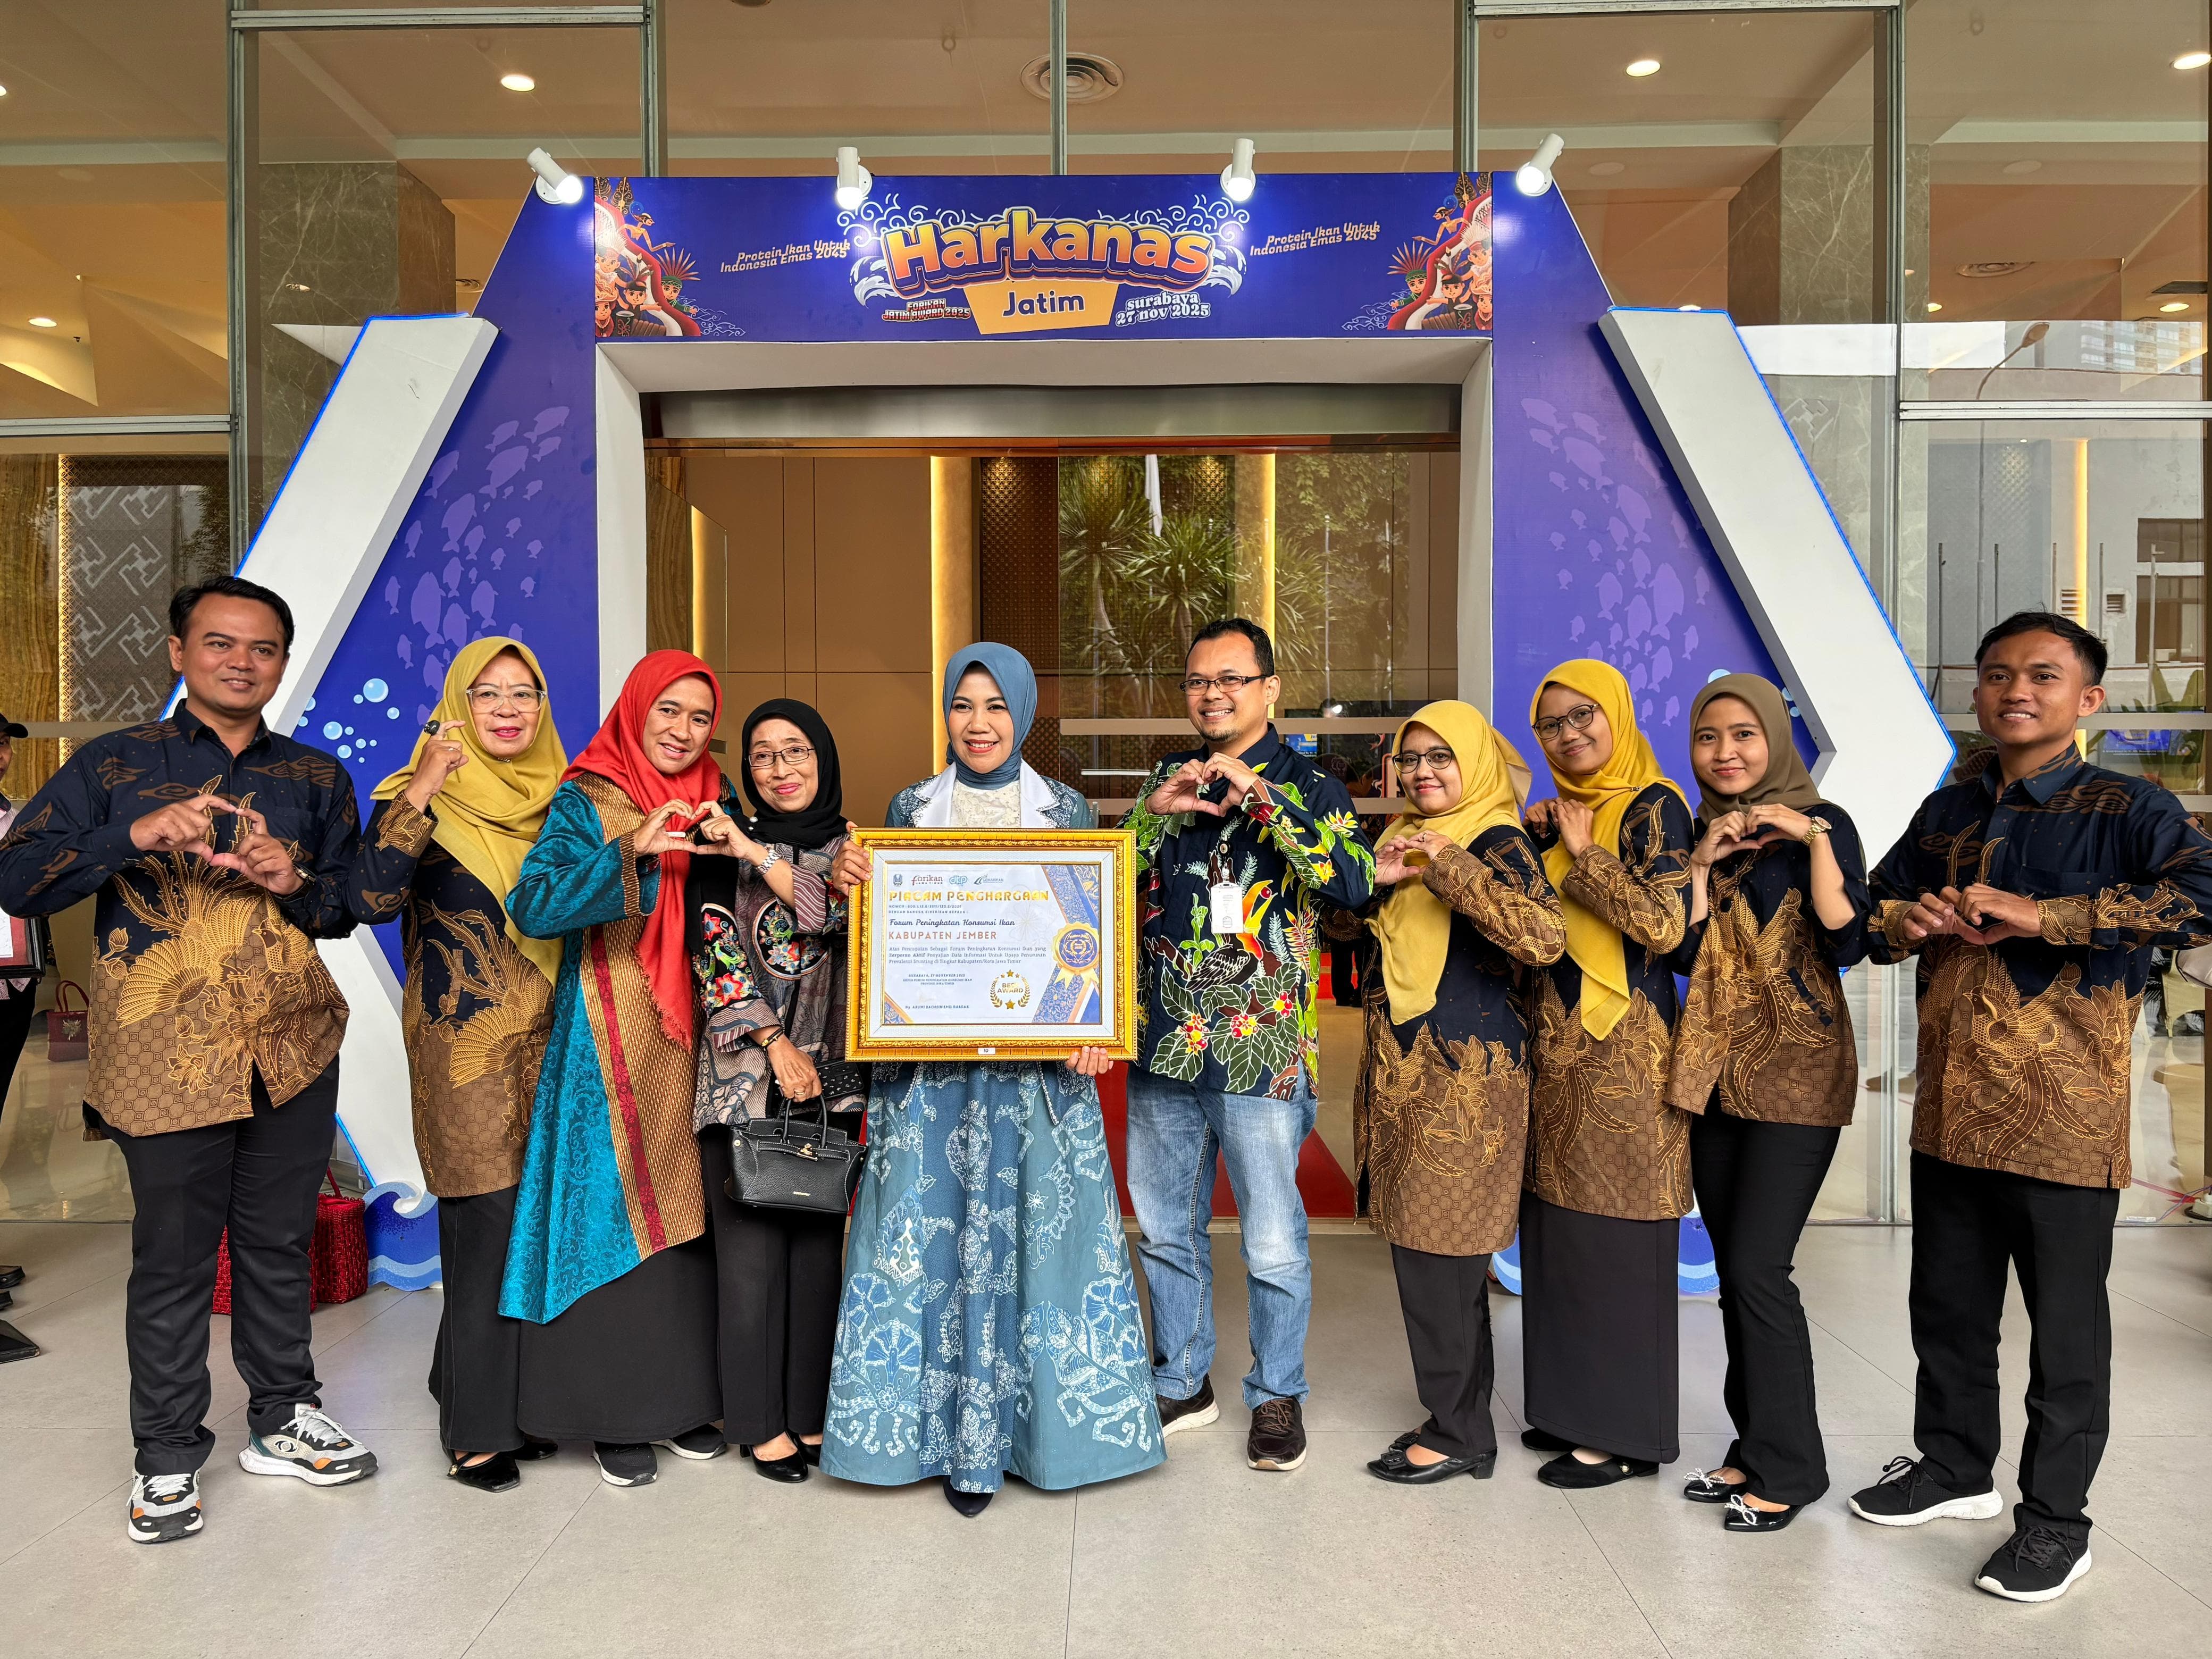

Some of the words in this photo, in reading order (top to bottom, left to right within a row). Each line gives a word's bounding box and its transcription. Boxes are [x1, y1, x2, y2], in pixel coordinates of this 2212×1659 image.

[1250, 241, 1307, 256] Indonesia
[1310, 234, 1343, 247] Emas
[1345, 230, 1377, 241] 2045
[1267, 229, 1311, 246] Protein
[1314, 226, 1340, 239] Ikan
[1343, 221, 1380, 233] Untuk
[736, 247, 782, 264] Protein
[783, 243, 810, 256] Ikan
[814, 239, 851, 251] Untuk
[884, 207, 1214, 287] Harkanas
[720, 258, 777, 273] Indonesia
[780, 252, 813, 264] Emas
[816, 248, 847, 259] 2045
[907, 299, 945, 311] FORIKAN
[1002, 291, 1084, 317] Jatim
[1126, 291, 1200, 311] surabaya
[883, 311, 911, 321] JATIM
[911, 308, 944, 320] AWARD
[944, 307, 970, 319] 2025
[1116, 310, 1136, 325] 27
[1138, 307, 1168, 321] nov
[1171, 304, 1210, 317] 2025
[911, 875, 943, 886] forikan
[889, 891, 942, 901] PIAGAM
[947, 890, 1049, 901] PENGHARGAAN
[916, 919, 960, 928] Peningkatan
[889, 931, 952, 940] KABUPATEN
[956, 931, 997, 940] JEMBER
